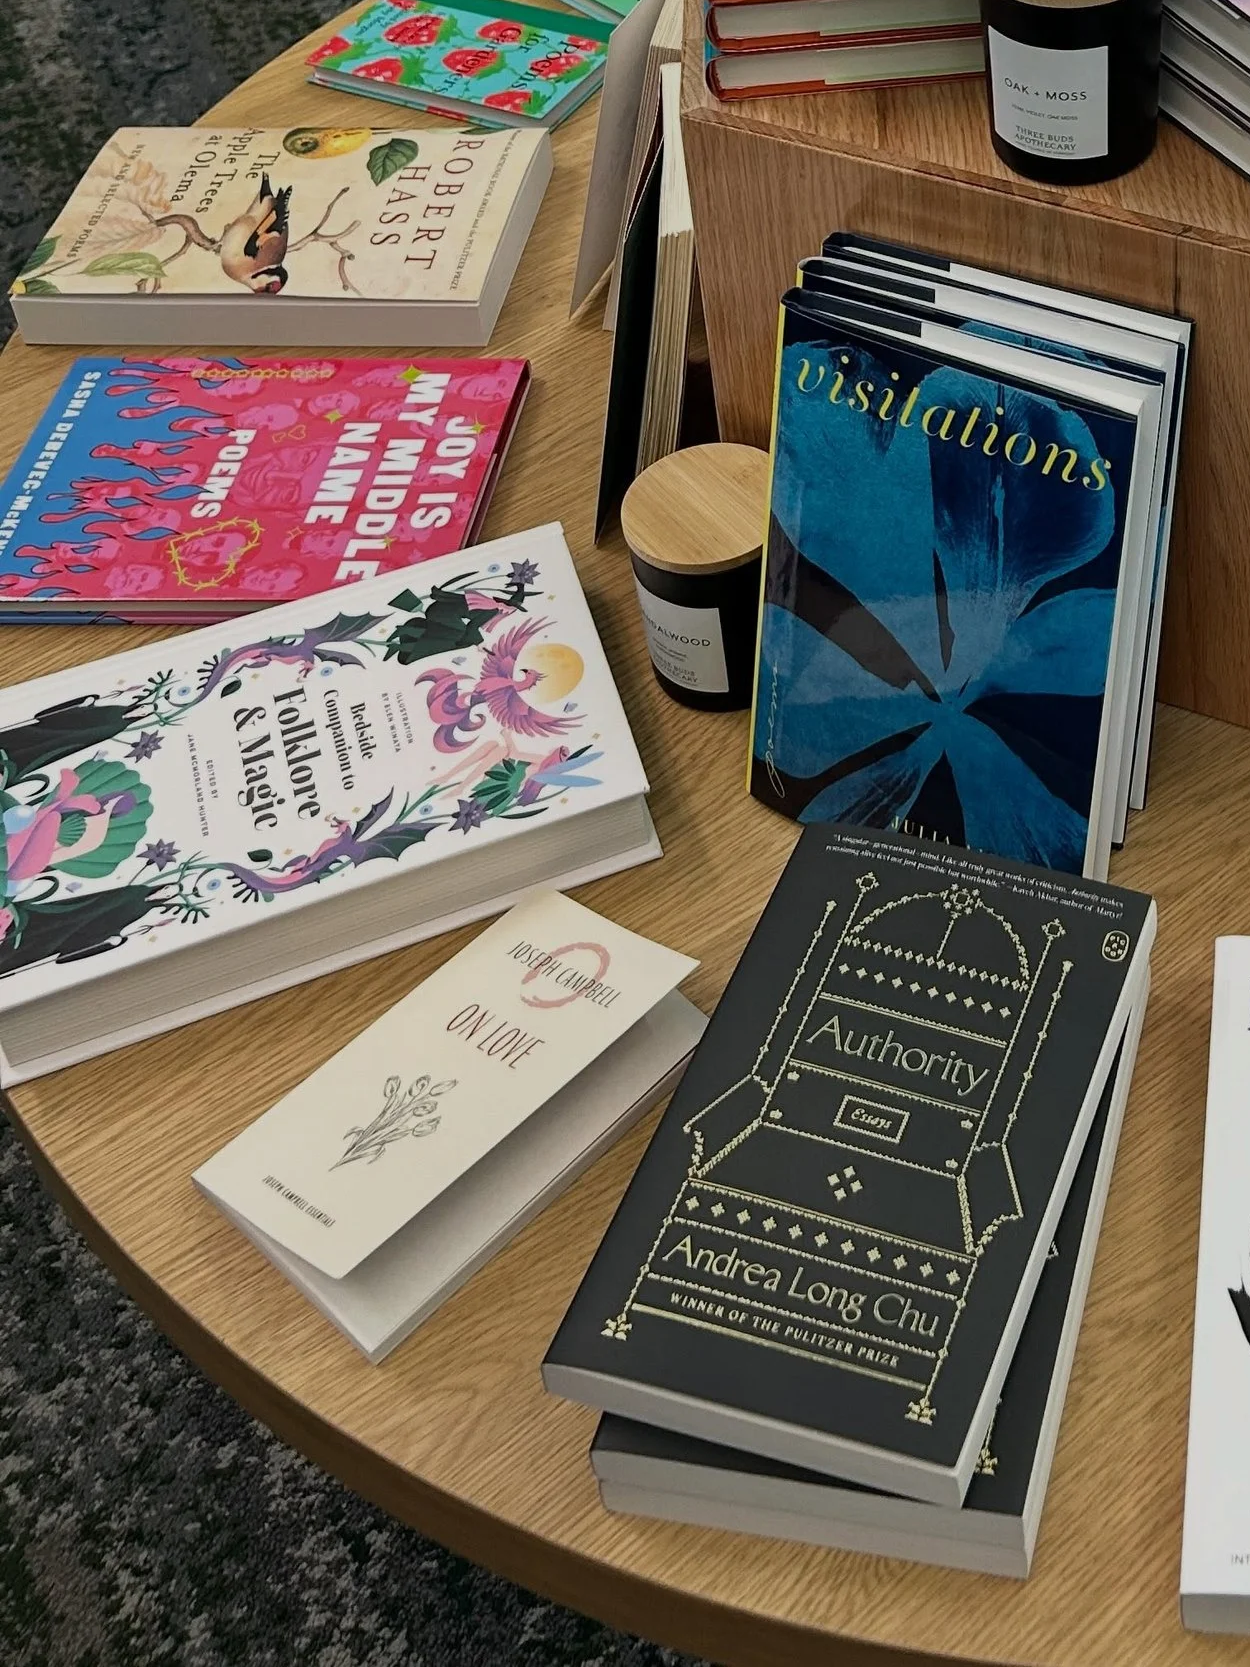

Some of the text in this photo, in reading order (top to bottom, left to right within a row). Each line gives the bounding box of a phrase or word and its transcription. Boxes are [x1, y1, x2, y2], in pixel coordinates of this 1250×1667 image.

[245, 149, 281, 183] The
[369, 165, 433, 249] HASS
[404, 139, 486, 270] ROBERT
[62, 370, 102, 419] SASHA
[796, 354, 1113, 493] visitations
[190, 428, 258, 519] POEMS
[303, 421, 383, 527] NAME
[334, 371, 453, 581] MY MIDDLE
[409, 415, 478, 531] JOY IS
[233, 705, 287, 833] & Magic
[272, 686, 323, 821] Folklore
[349, 701, 378, 762] Bedside
[505, 938, 623, 1011] JOSEPH CAMPBELL
[444, 1003, 546, 1072] ON LOVE
[805, 1014, 990, 1097] Authority
[849, 1106, 893, 1131] Essays
[661, 1233, 941, 1338] Andrea Long Chu
[669, 1291, 901, 1370] WINNER OF THE PULITZER PRIZE
